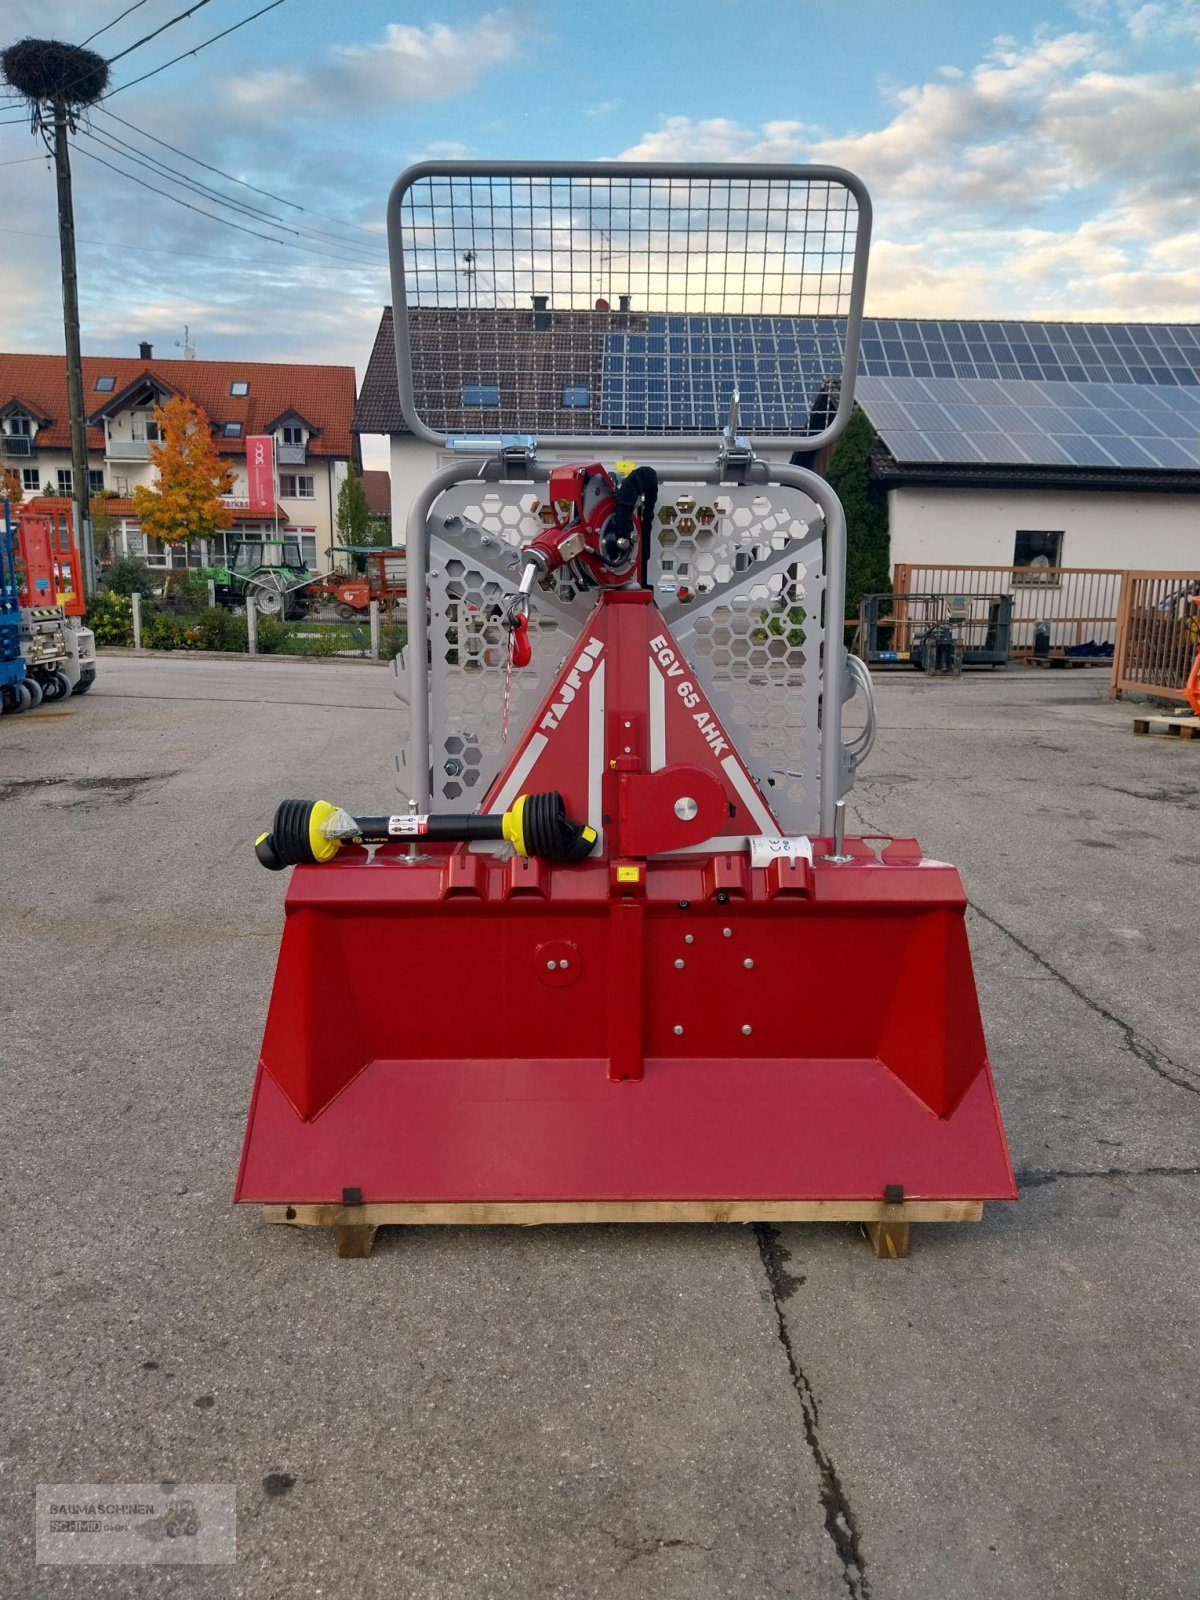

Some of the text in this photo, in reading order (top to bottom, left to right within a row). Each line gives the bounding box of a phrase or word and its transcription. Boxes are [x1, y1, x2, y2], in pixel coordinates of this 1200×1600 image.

[539, 636, 605, 730] TAJFUN
[649, 634, 729, 757] EGV 65 AHK
